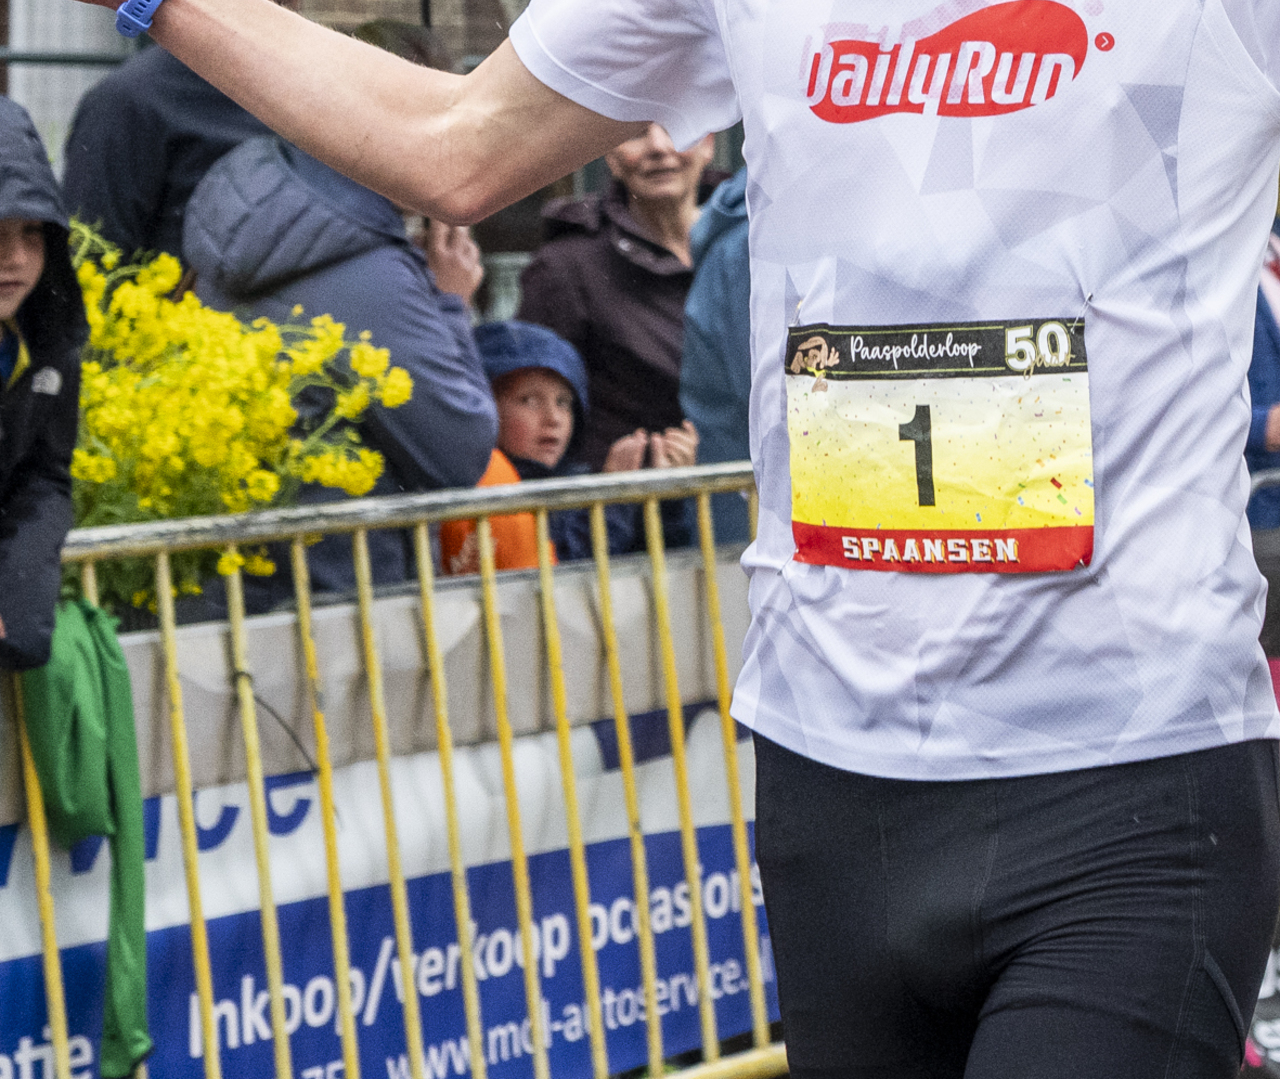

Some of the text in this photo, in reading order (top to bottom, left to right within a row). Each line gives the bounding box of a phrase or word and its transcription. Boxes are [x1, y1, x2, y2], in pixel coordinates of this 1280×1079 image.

[802, 37, 1077, 116] DailyRun
[850, 321, 1071, 372] Paaspolderloop 50
[898, 404, 936, 507] 1
[841, 536, 1020, 564] SPAANSEN
[190, 911, 574, 1059] Inkoop/verkoop
[386, 935, 774, 1079] www.mol-atoservce.l
